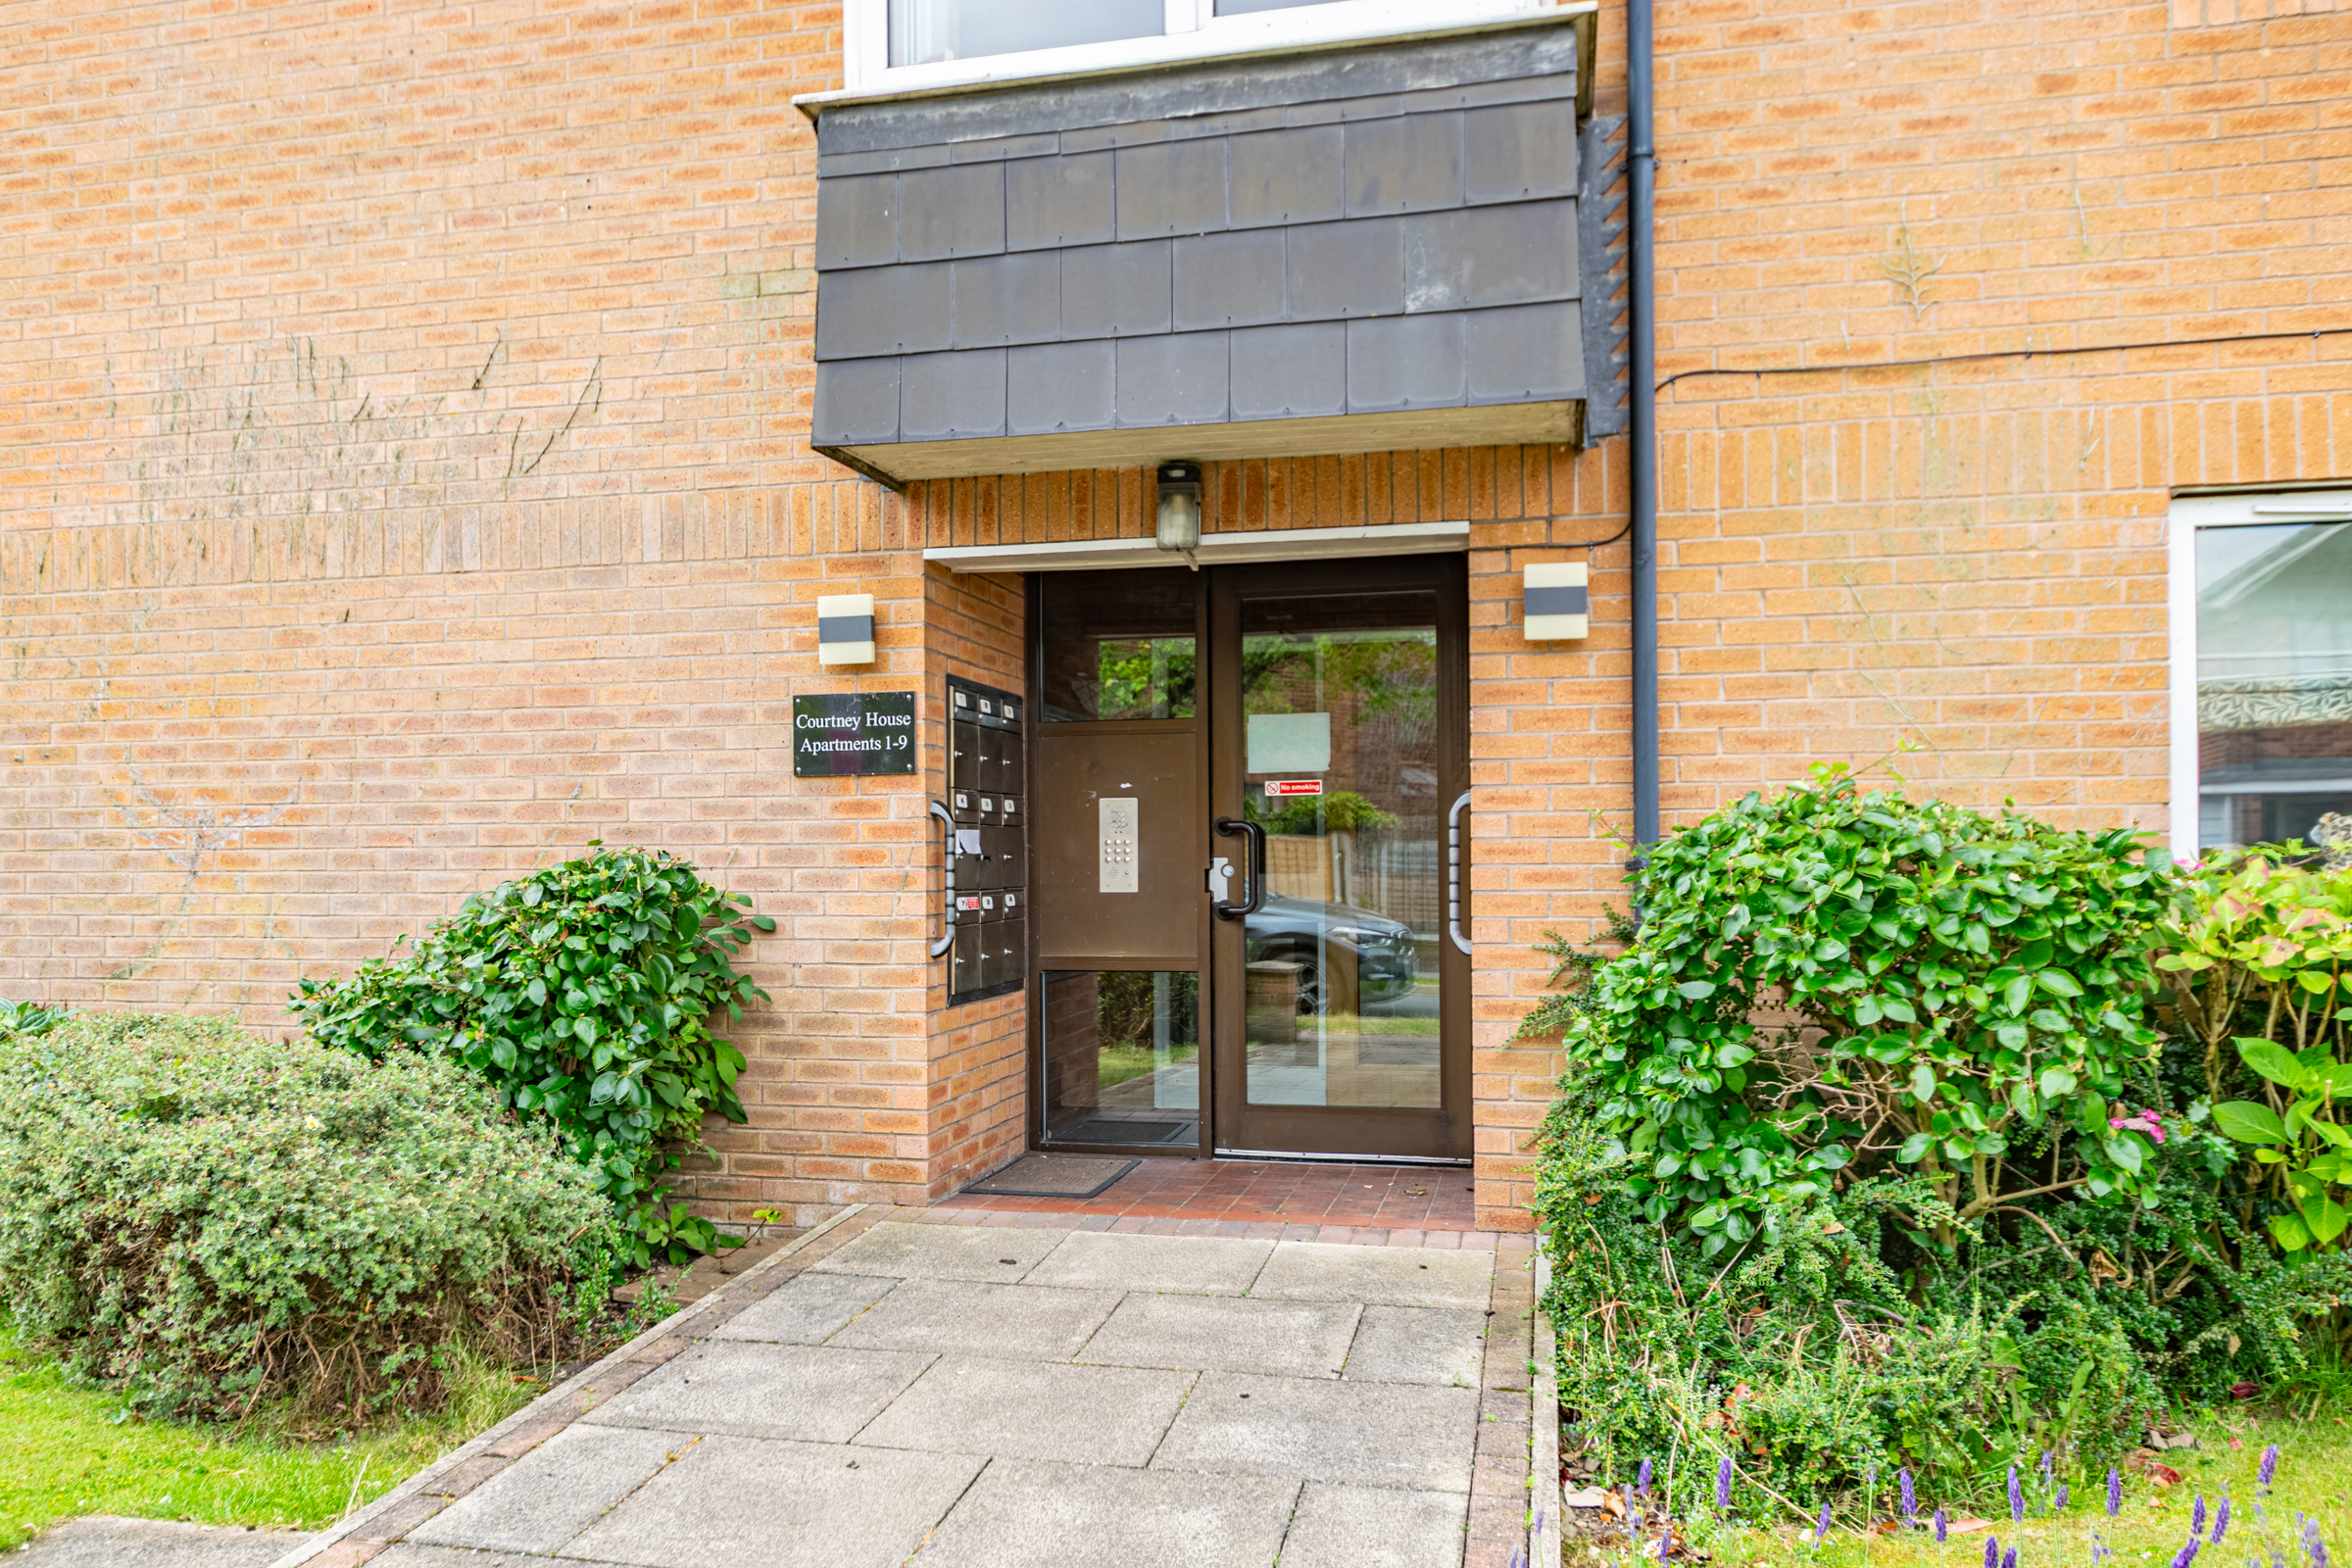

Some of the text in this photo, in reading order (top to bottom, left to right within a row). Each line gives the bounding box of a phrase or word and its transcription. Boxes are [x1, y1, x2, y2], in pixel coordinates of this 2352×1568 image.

[796, 712, 911, 731] Courtney House
[800, 735, 908, 756] Apartments 1-9
